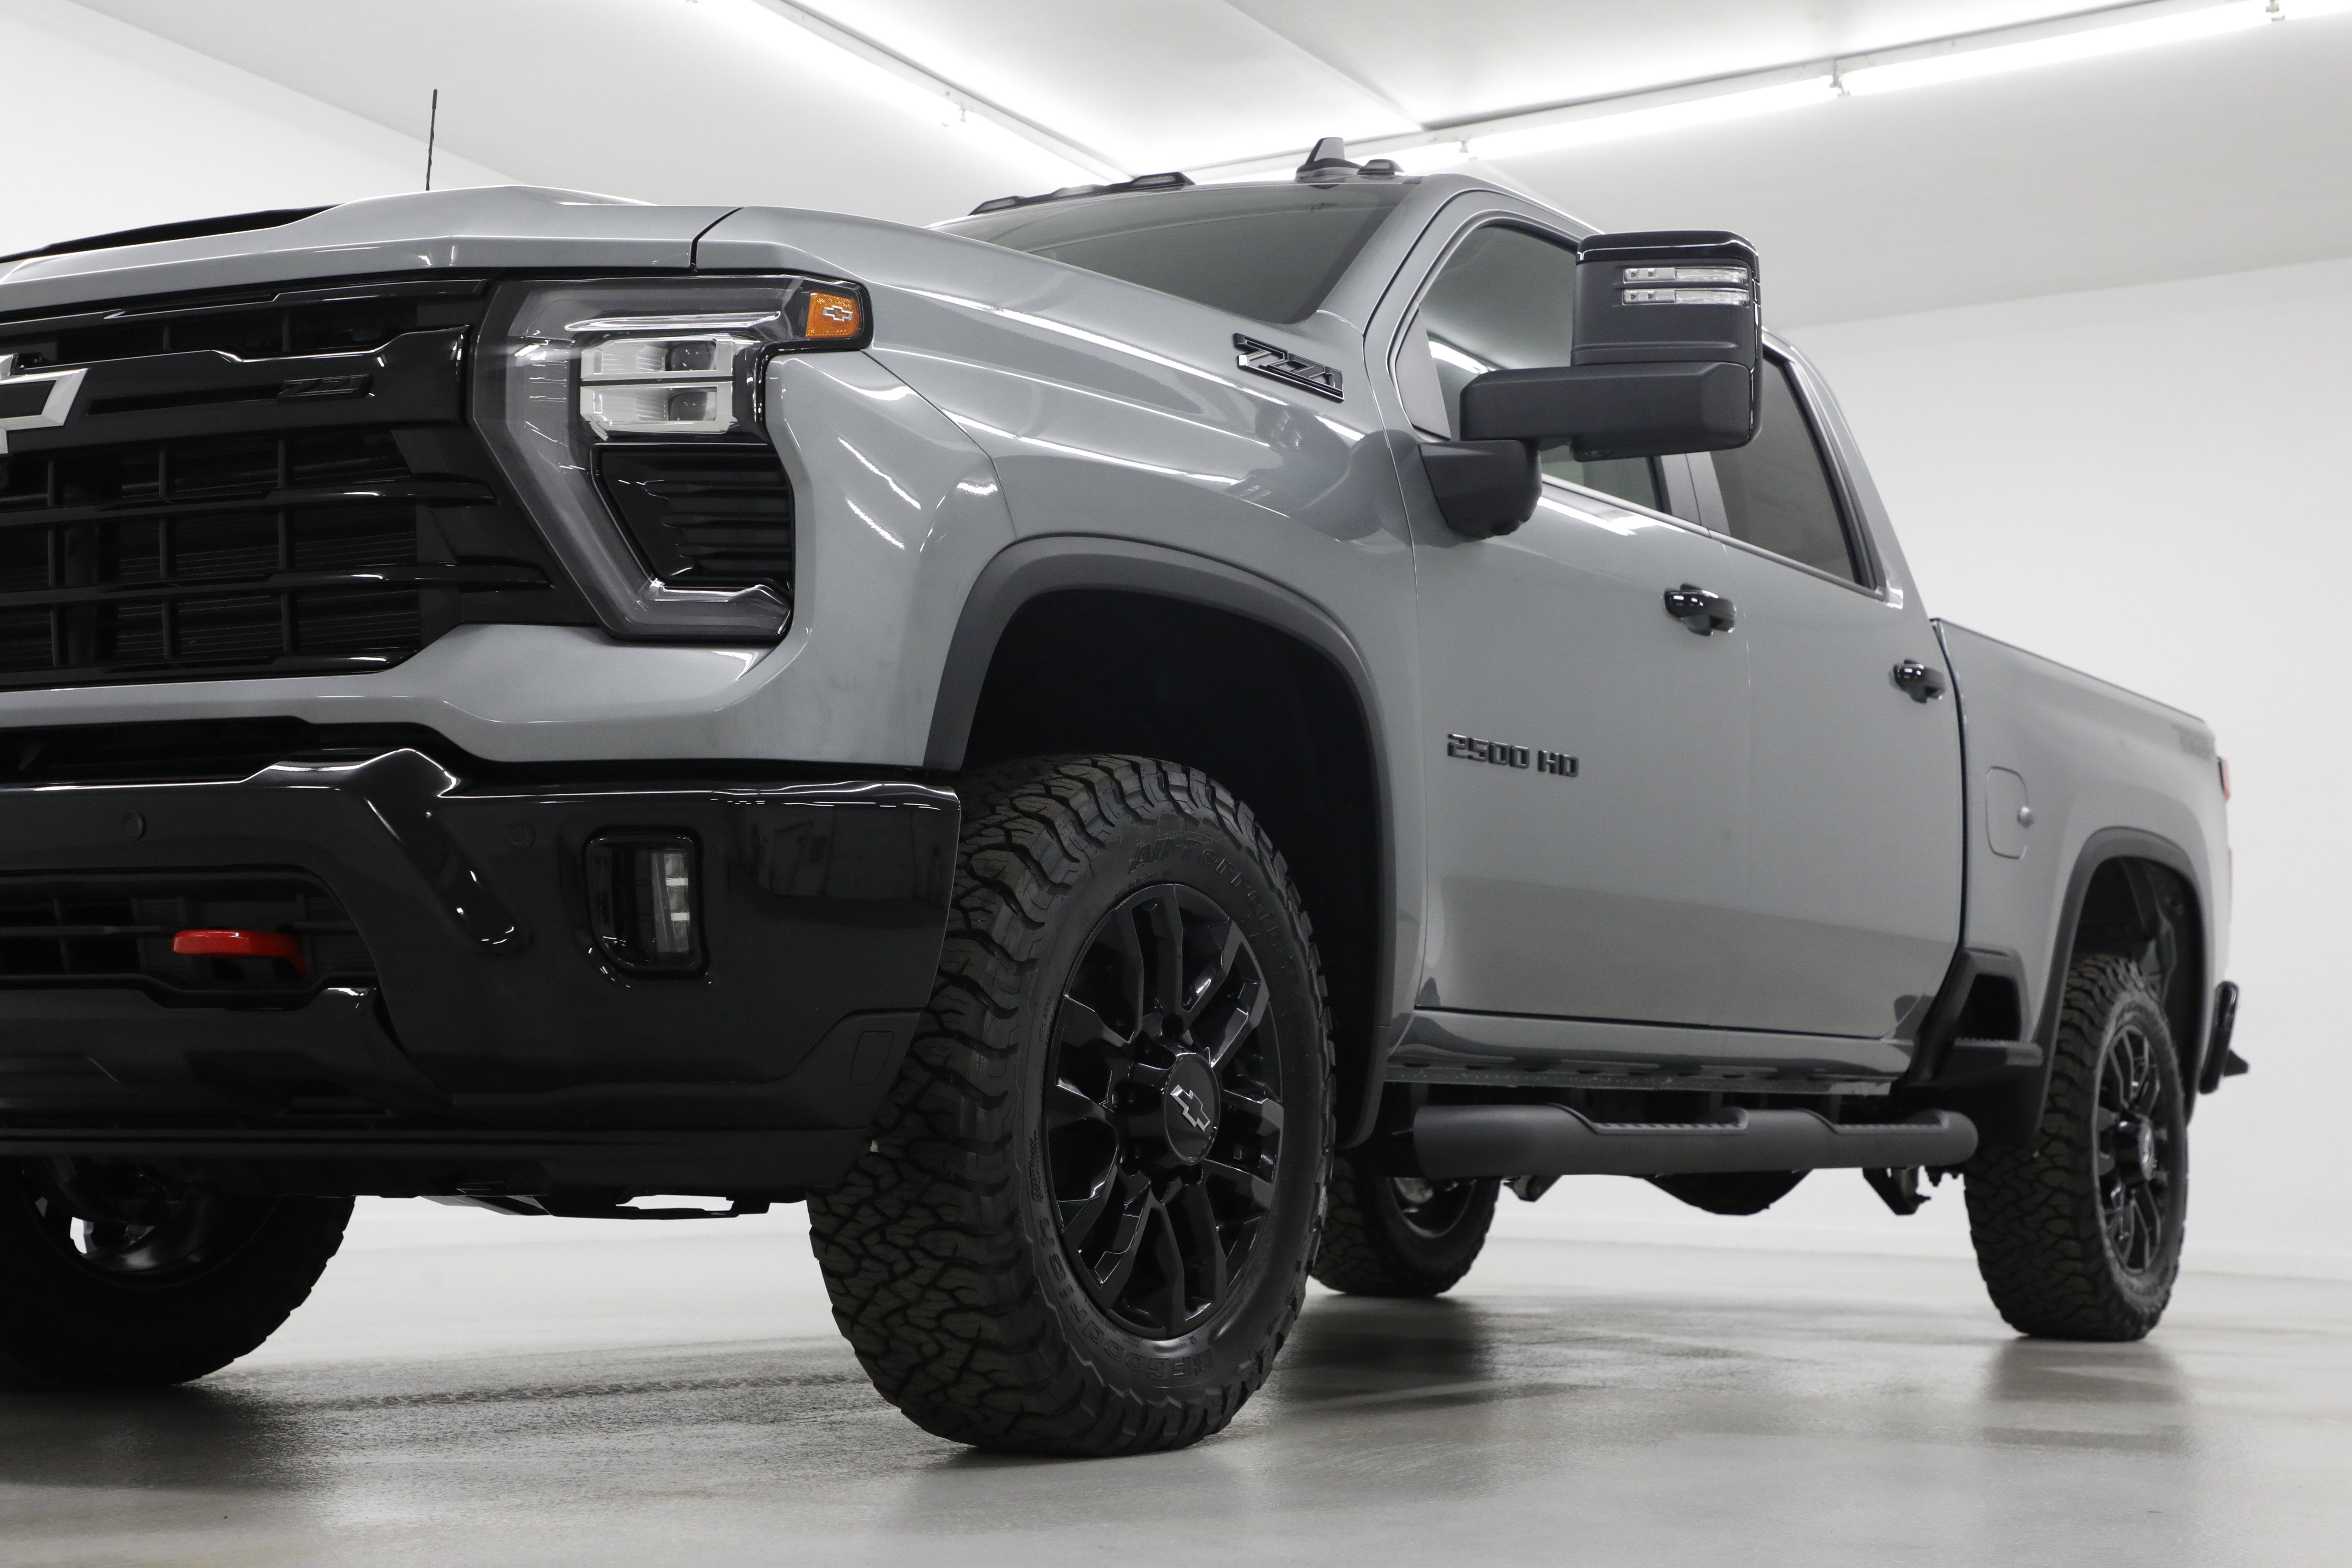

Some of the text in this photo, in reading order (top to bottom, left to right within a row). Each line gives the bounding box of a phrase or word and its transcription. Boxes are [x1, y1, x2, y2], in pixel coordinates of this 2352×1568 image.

[277, 373, 373, 402] Z71
[1233, 332, 1345, 403] Z71
[1447, 734, 1579, 777] 2500 HD
